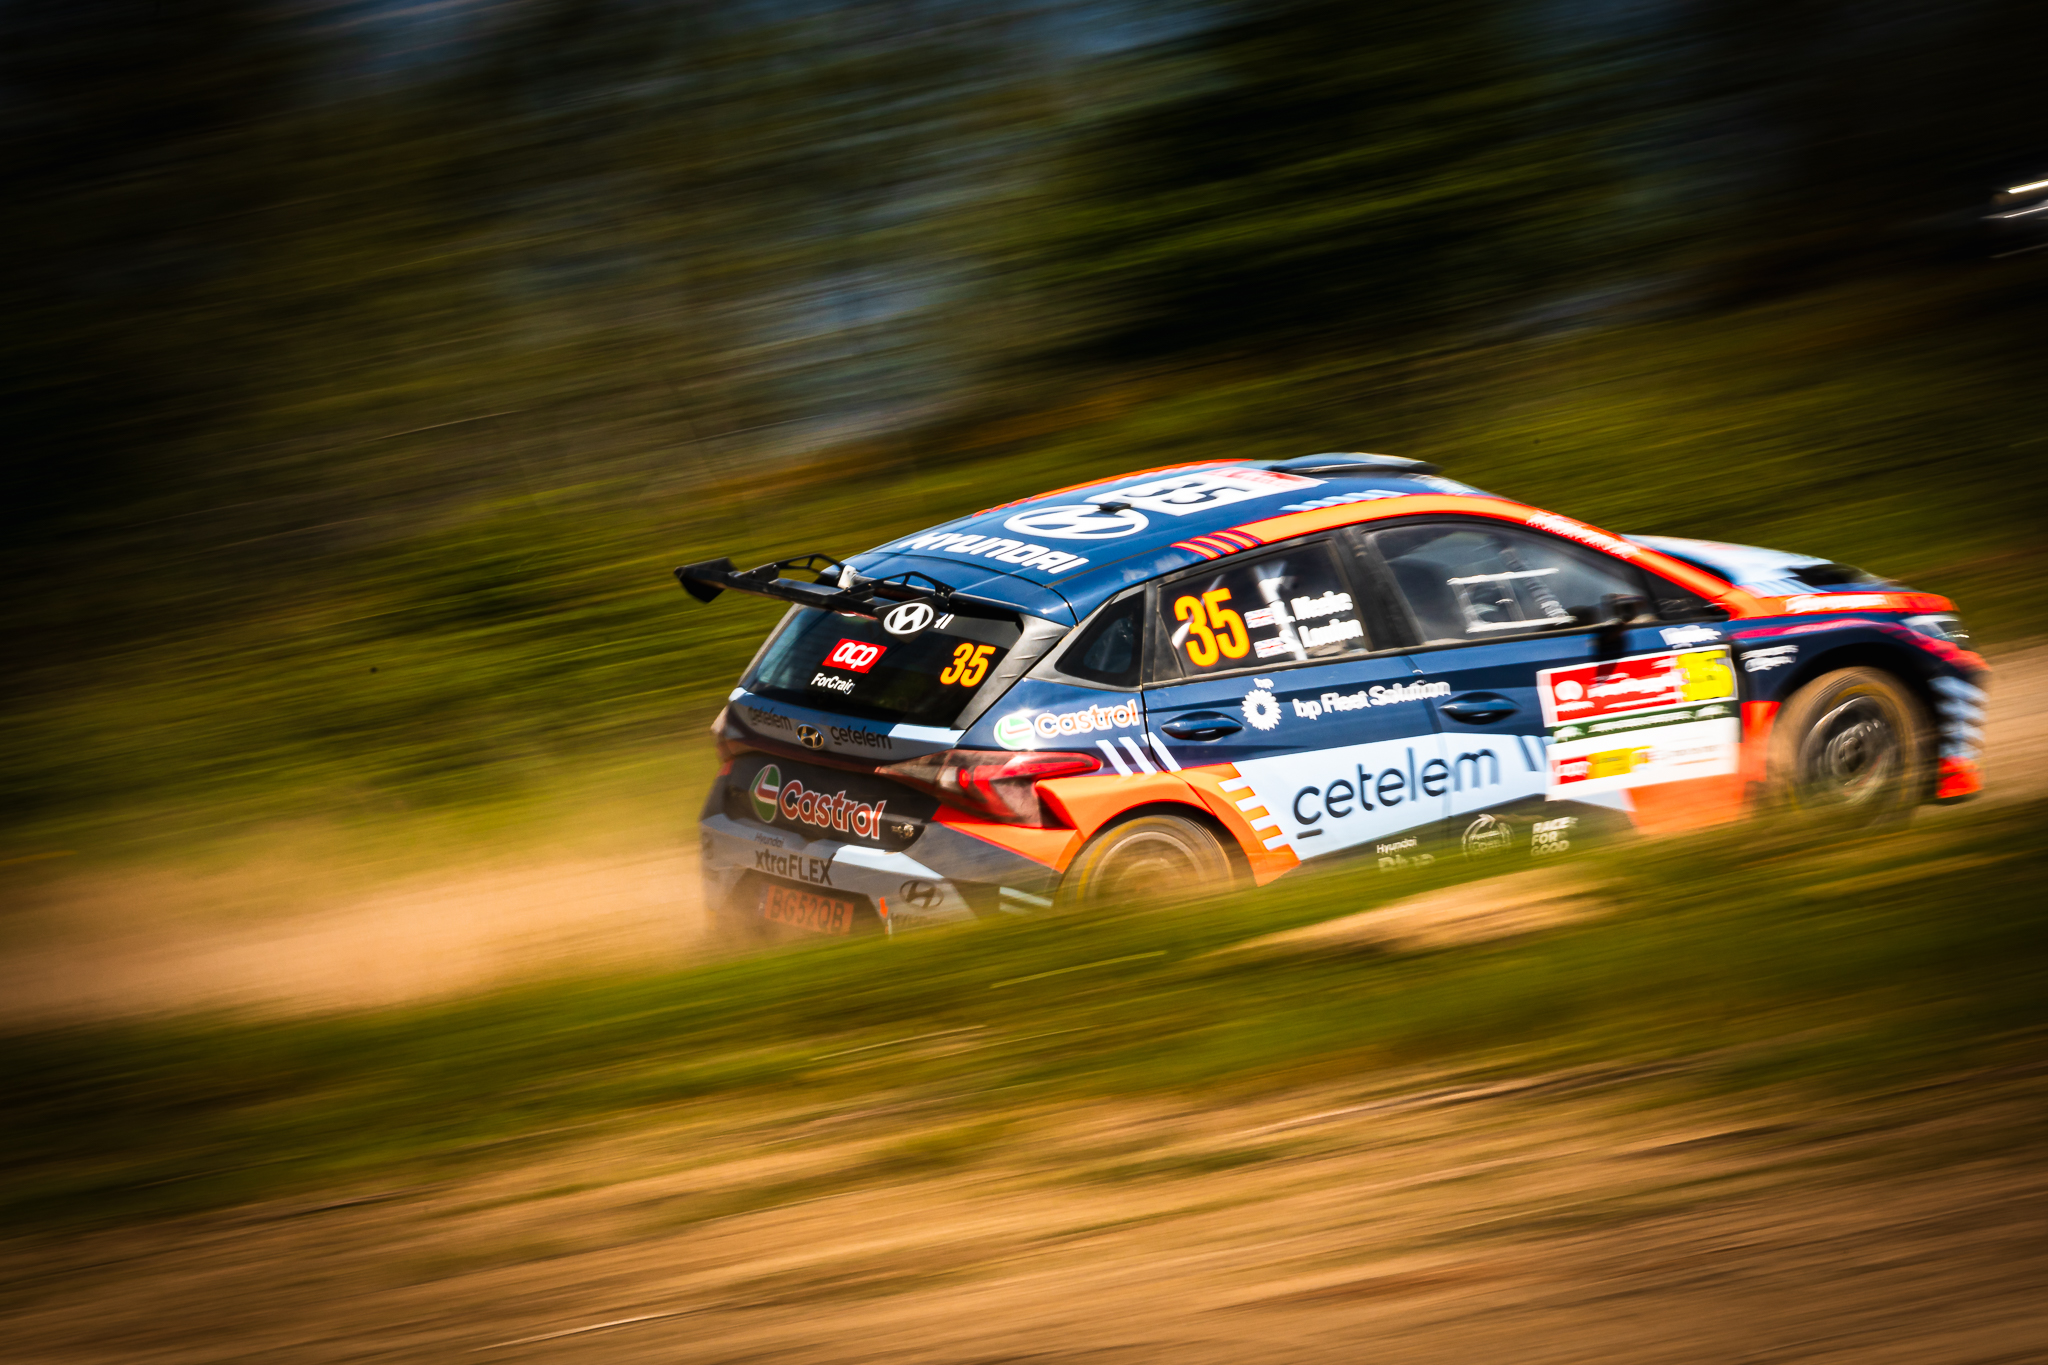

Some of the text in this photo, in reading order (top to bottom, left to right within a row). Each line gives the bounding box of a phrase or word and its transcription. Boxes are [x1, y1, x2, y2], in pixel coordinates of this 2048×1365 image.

[896, 532, 1090, 575] HYUNDAI
[1174, 587, 1251, 667] 35
[832, 642, 879, 669] acp
[939, 642, 997, 688] 35
[810, 672, 856, 695] ForCraig
[830, 725, 893, 750] cetelem
[1033, 699, 1141, 739] Castrol
[779, 779, 887, 840] Castrol
[1291, 746, 1500, 840] cetelem
[1531, 831, 1559, 846] FOR
[755, 848, 837, 886] xtraFLEX
